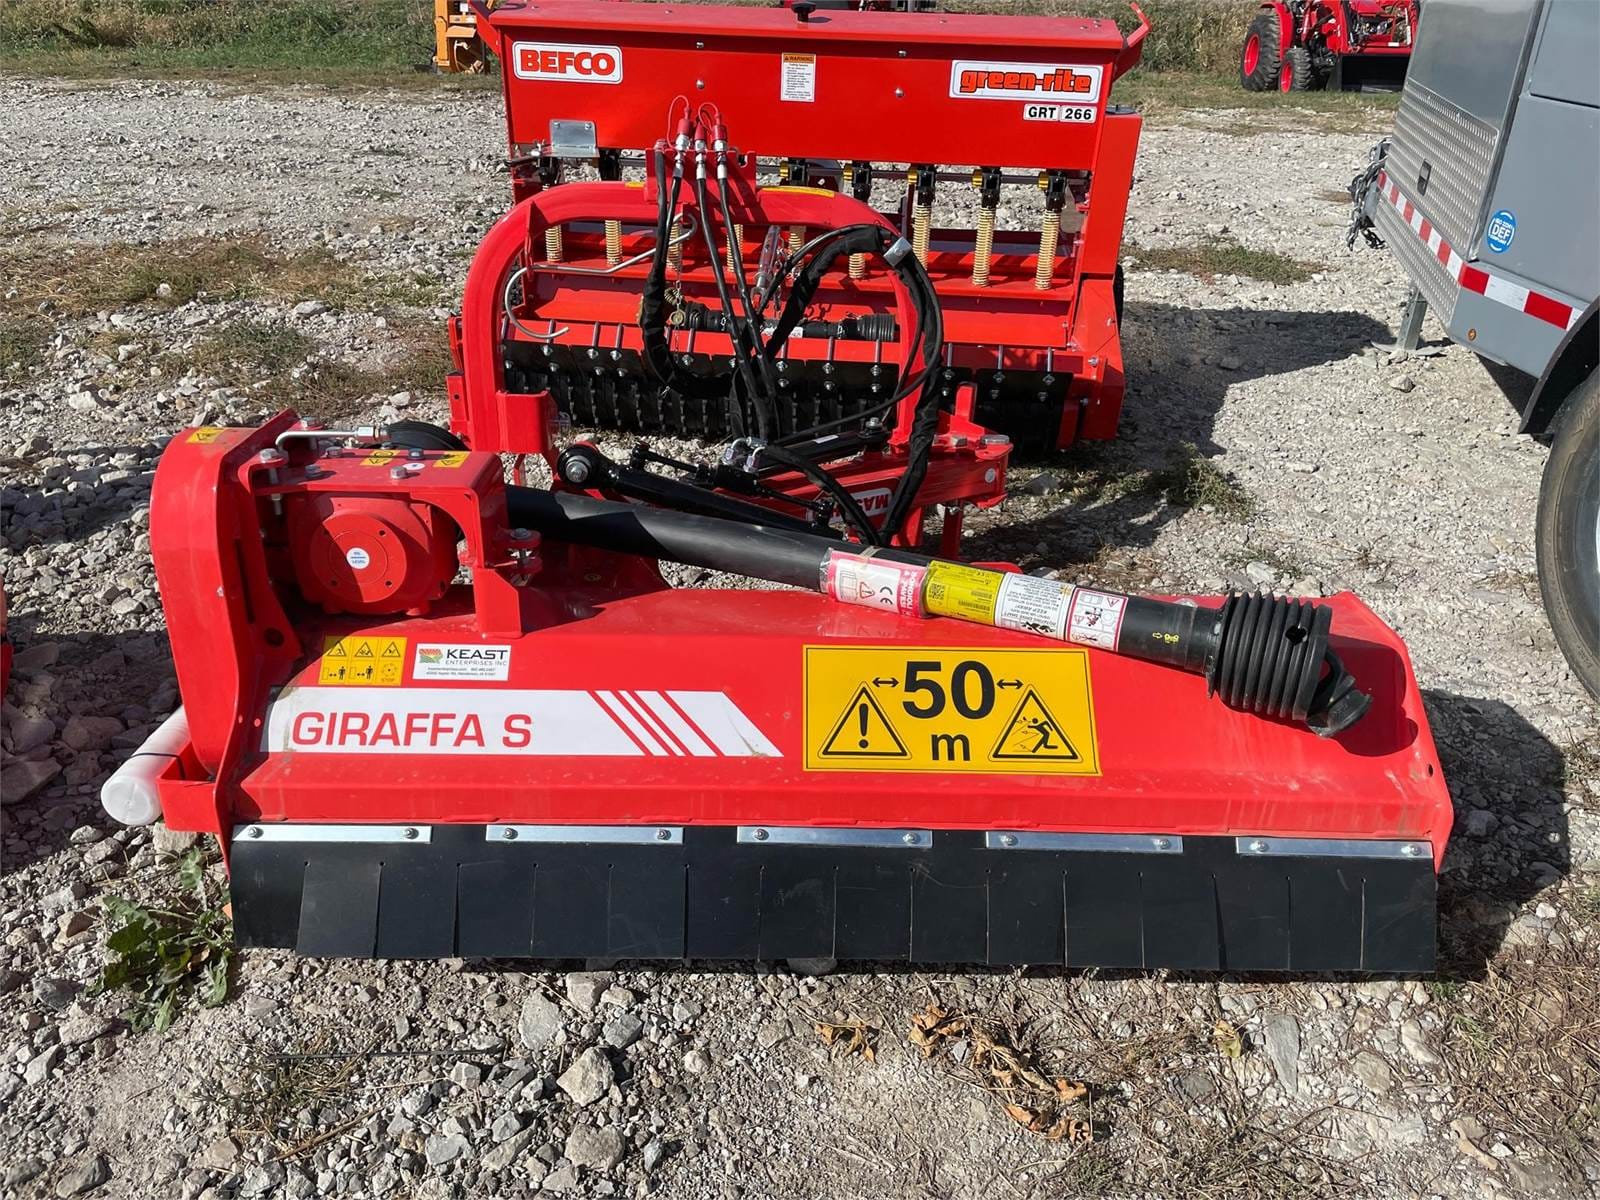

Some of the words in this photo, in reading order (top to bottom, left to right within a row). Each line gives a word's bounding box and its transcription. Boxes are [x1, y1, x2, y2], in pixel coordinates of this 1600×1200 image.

[520, 49, 616, 76] BEFCO
[960, 68, 1092, 93] green-rite
[1028, 106, 1056, 118] GRT
[1065, 108, 1092, 120] 266
[1492, 223, 1511, 240] DEF
[446, 649, 508, 660] KEAST
[902, 660, 996, 719] 50
[291, 712, 486, 747] GIRAFFA
[502, 714, 532, 748] S
[931, 733, 970, 761] m
